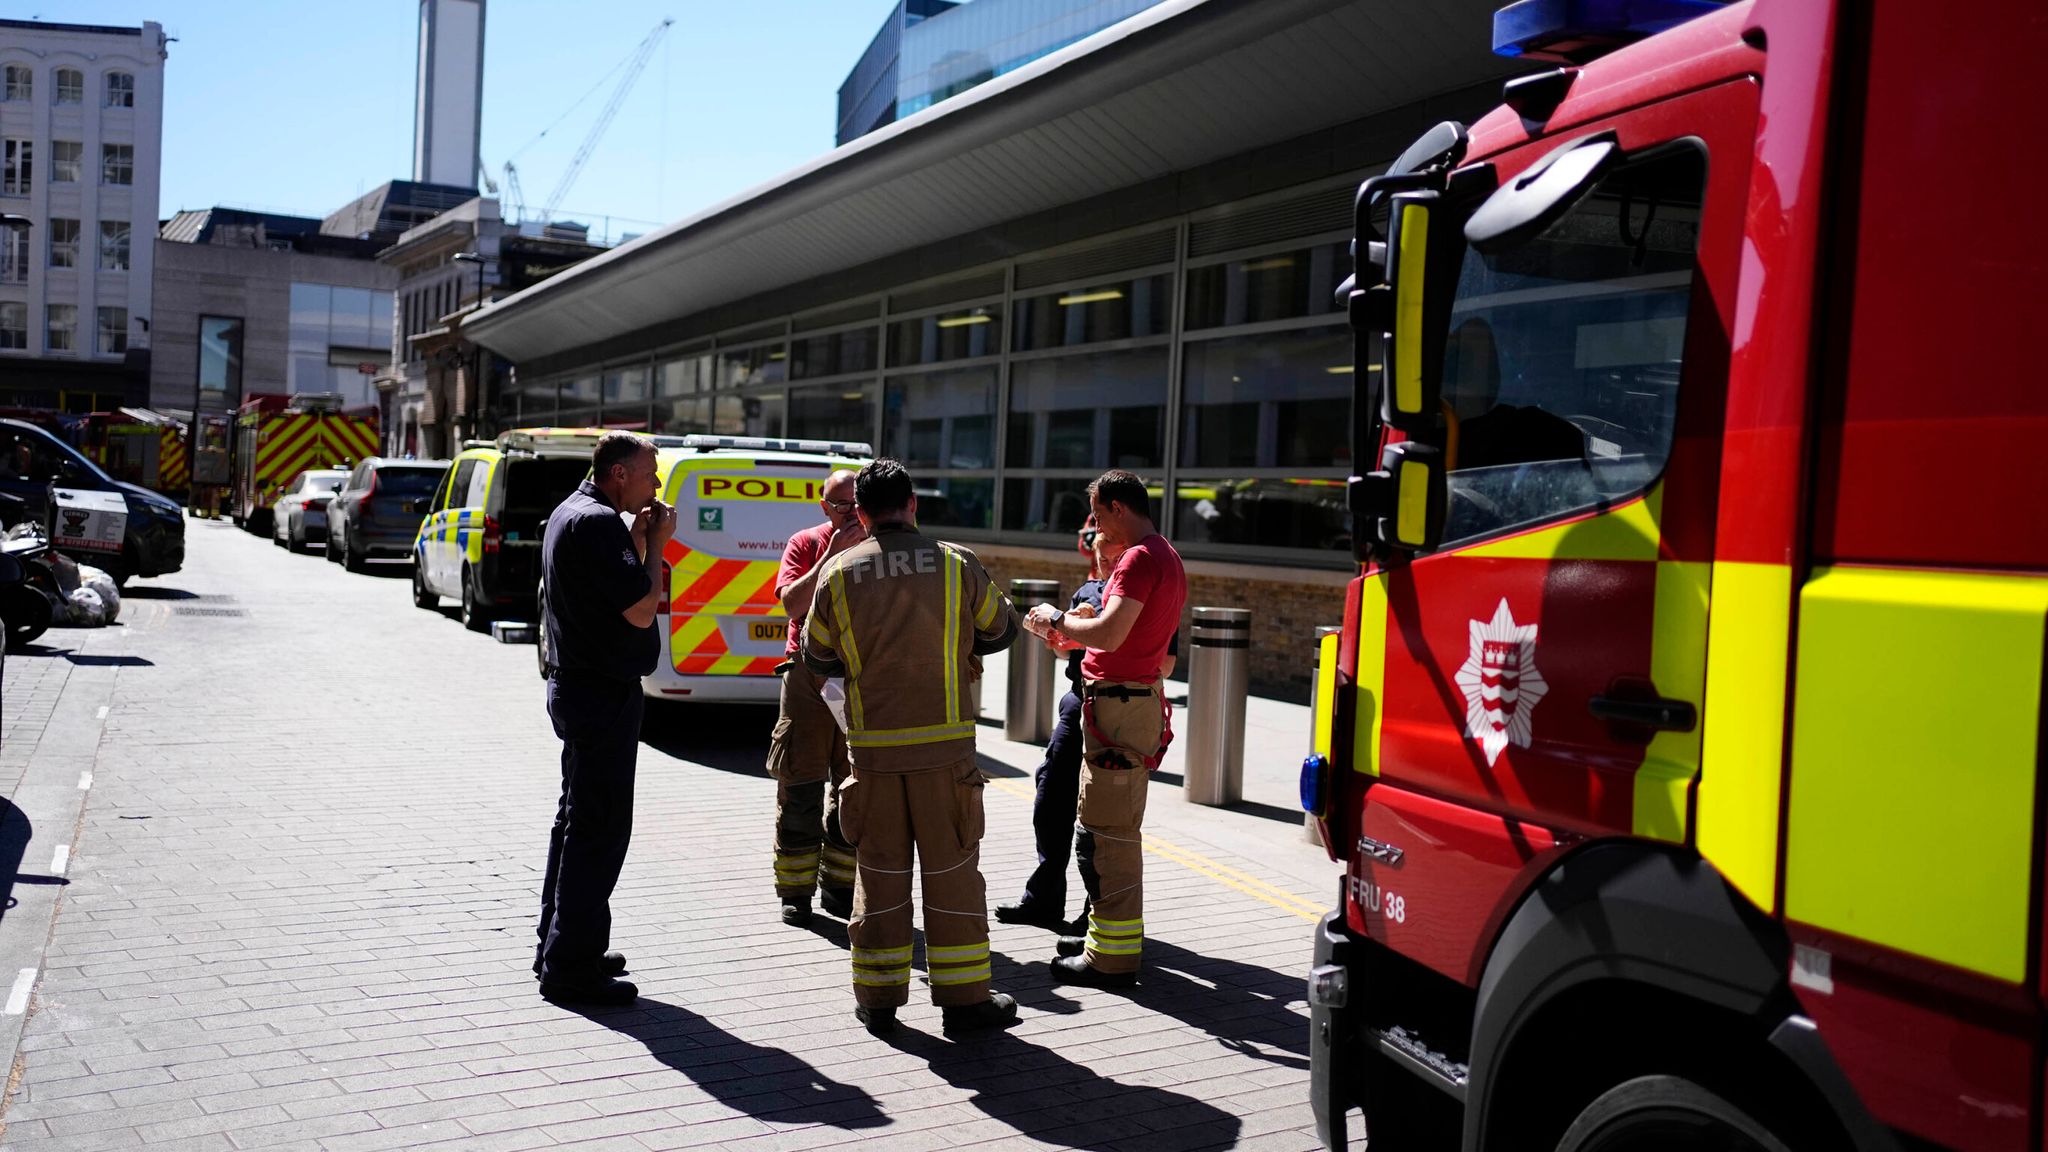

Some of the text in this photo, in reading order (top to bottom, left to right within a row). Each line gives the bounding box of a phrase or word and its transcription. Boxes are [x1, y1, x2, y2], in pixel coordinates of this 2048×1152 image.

[703, 478, 824, 500] POLI
[852, 548, 937, 584] FIRE
[1351, 876, 1405, 924] FRU 38
